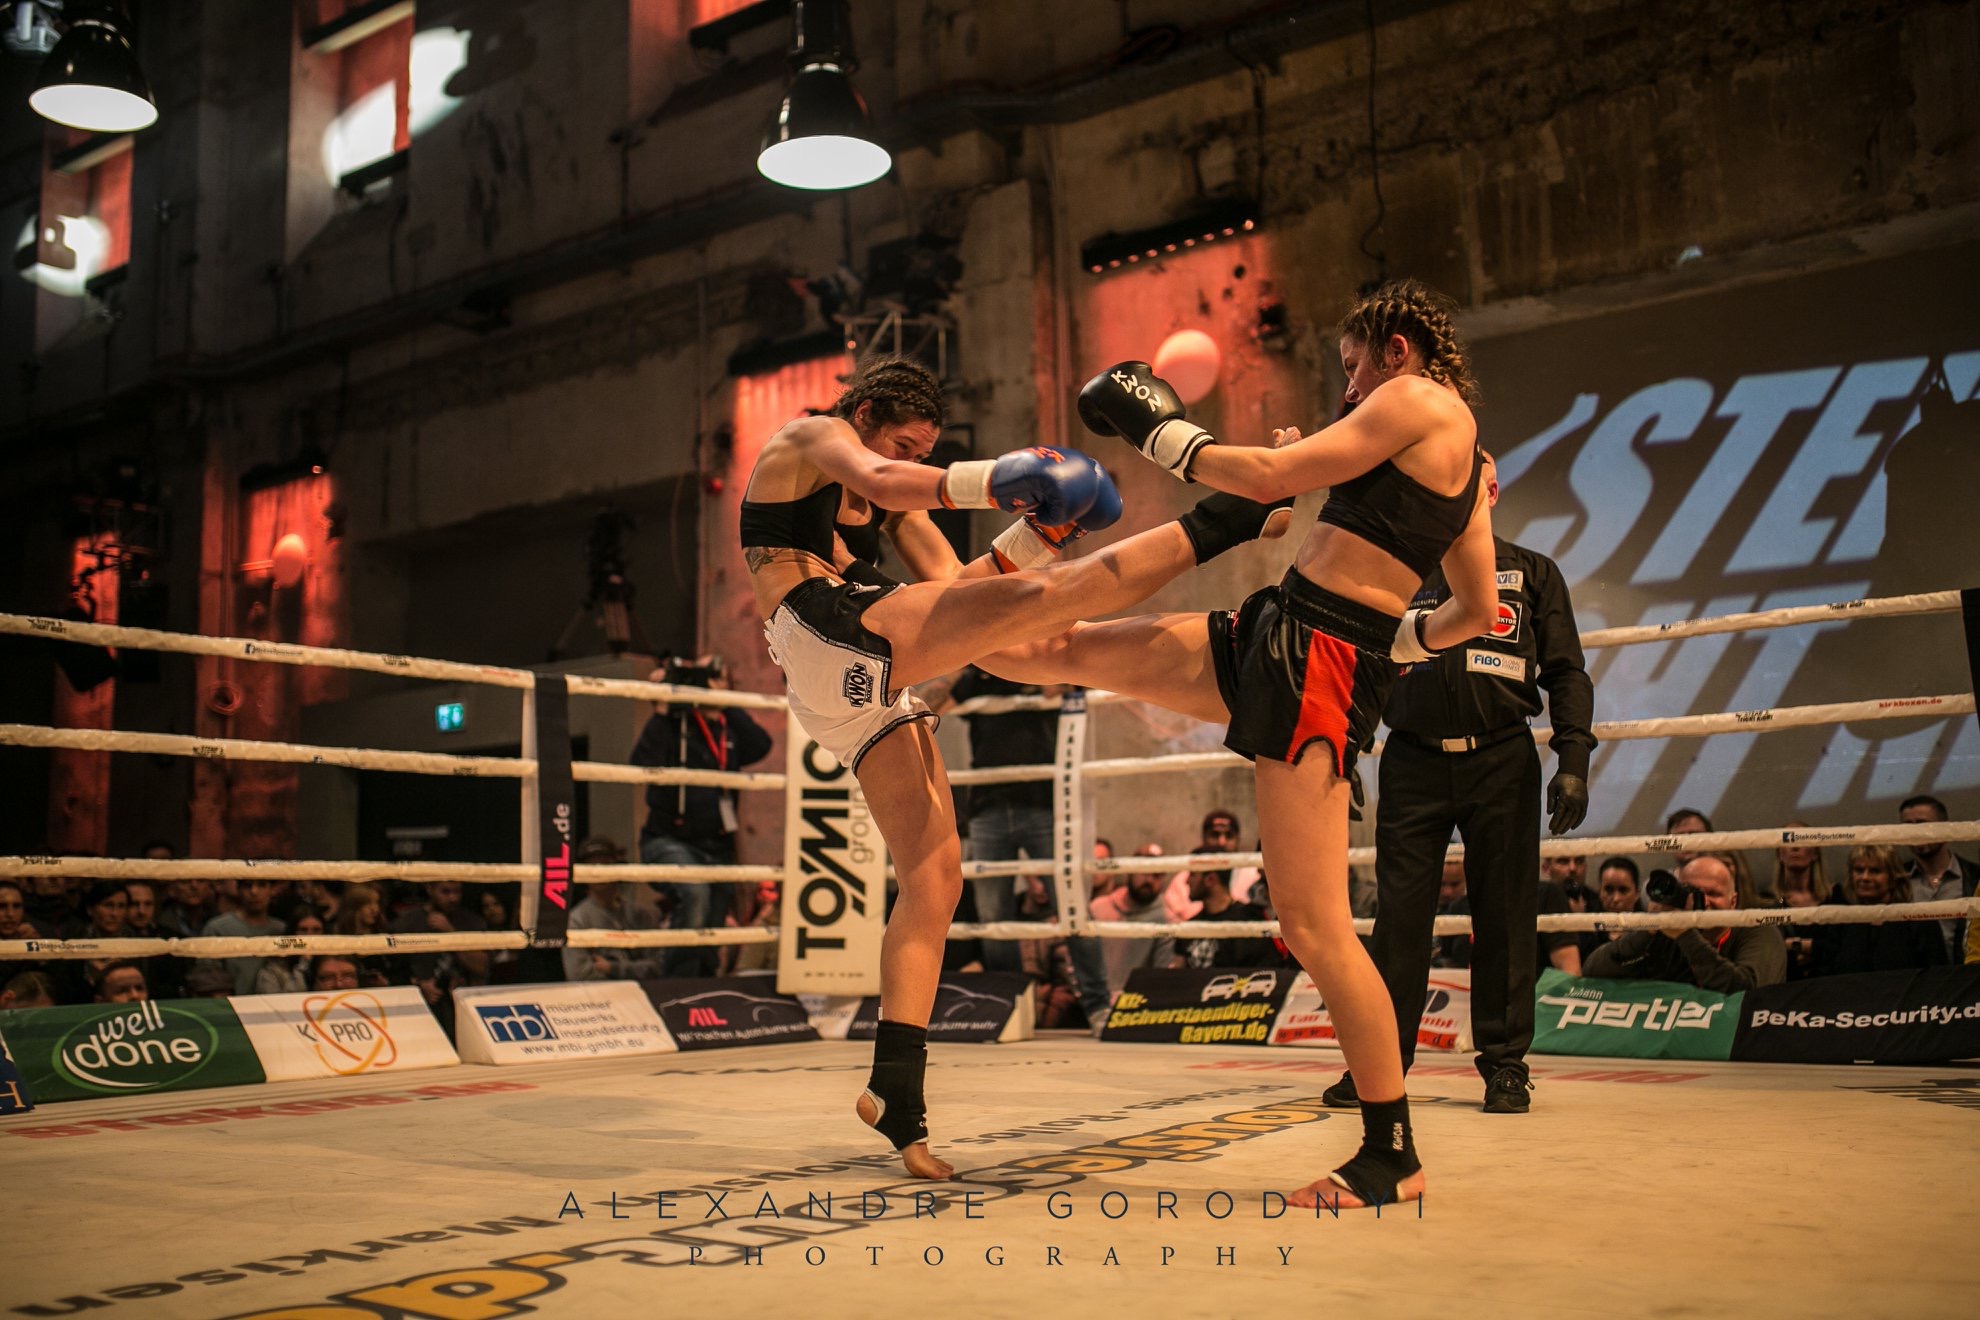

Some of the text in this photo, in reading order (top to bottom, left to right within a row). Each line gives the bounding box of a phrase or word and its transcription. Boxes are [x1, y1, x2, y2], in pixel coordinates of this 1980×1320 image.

[1110, 370, 1162, 412] KWON
[1474, 654, 1502, 667] FIBO
[848, 663, 866, 706] KWON
[99, 1000, 165, 1044] well
[482, 1004, 558, 1041] mbi
[1179, 1020, 1268, 1045] Bayern.de
[74, 1034, 201, 1069] done
[951, 1114, 1130, 1145] Rollos
[591, 1151, 930, 1208] alousien
[9, 1216, 564, 1318] Markisen
